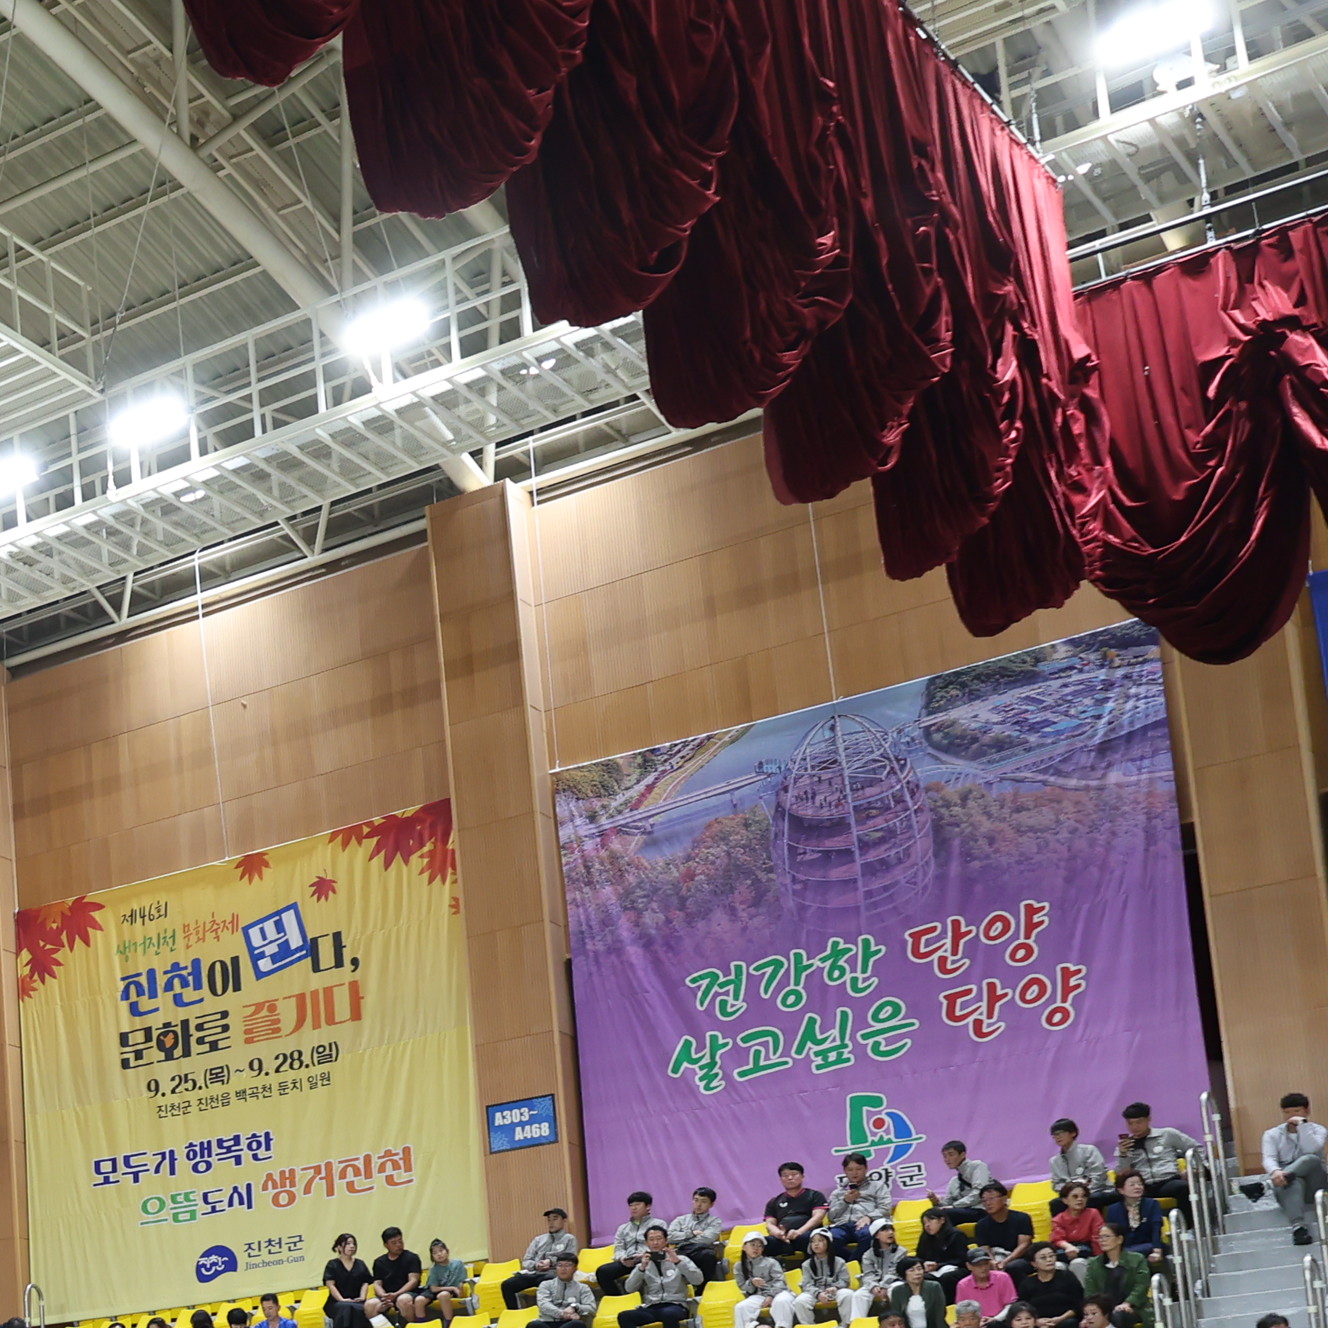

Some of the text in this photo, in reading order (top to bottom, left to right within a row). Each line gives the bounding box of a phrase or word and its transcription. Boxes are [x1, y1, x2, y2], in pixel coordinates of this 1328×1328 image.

[115, 911, 240, 963] 생거진천 문화축제
[121, 900, 168, 926] 제46회
[119, 905, 361, 1018] 진천이 뛴다,
[685, 900, 1050, 1020] 건강한 단양
[119, 980, 364, 1071] 문화로 즐기다
[668, 963, 1086, 1096] 살고싶은 단양
[156, 1071, 331, 1119] 진천군 진천읍 백곡천 둔치 일원
[494, 1107, 538, 1126] A303~
[514, 1122, 550, 1141] A468
[91, 1130, 274, 1188] 모두가 행복한
[836, 1163, 925, 1189] 양군
[138, 1144, 416, 1228] 으뜸도시 생거진천
[243, 1234, 304, 1258] 진천군
[244, 1255, 305, 1271] Jincheon-Gun
